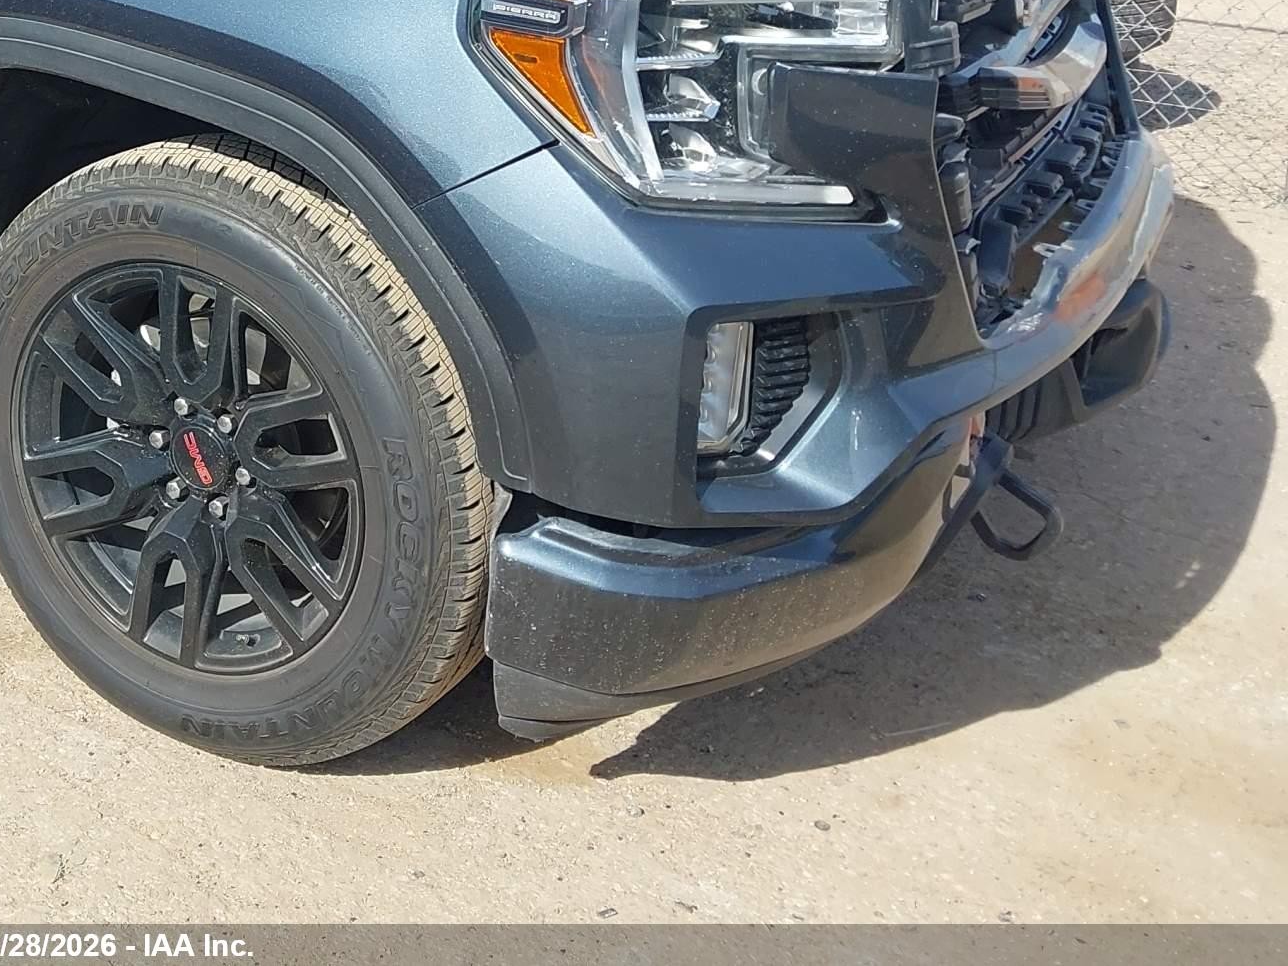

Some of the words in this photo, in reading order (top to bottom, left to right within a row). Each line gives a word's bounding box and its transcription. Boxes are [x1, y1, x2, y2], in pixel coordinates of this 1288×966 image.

[492, 3, 557, 21] SIERRA
[183, 431, 213, 486] GMC
[381, 436, 420, 639] ROCKY
[180, 632, 398, 741] MOUNTAIN
